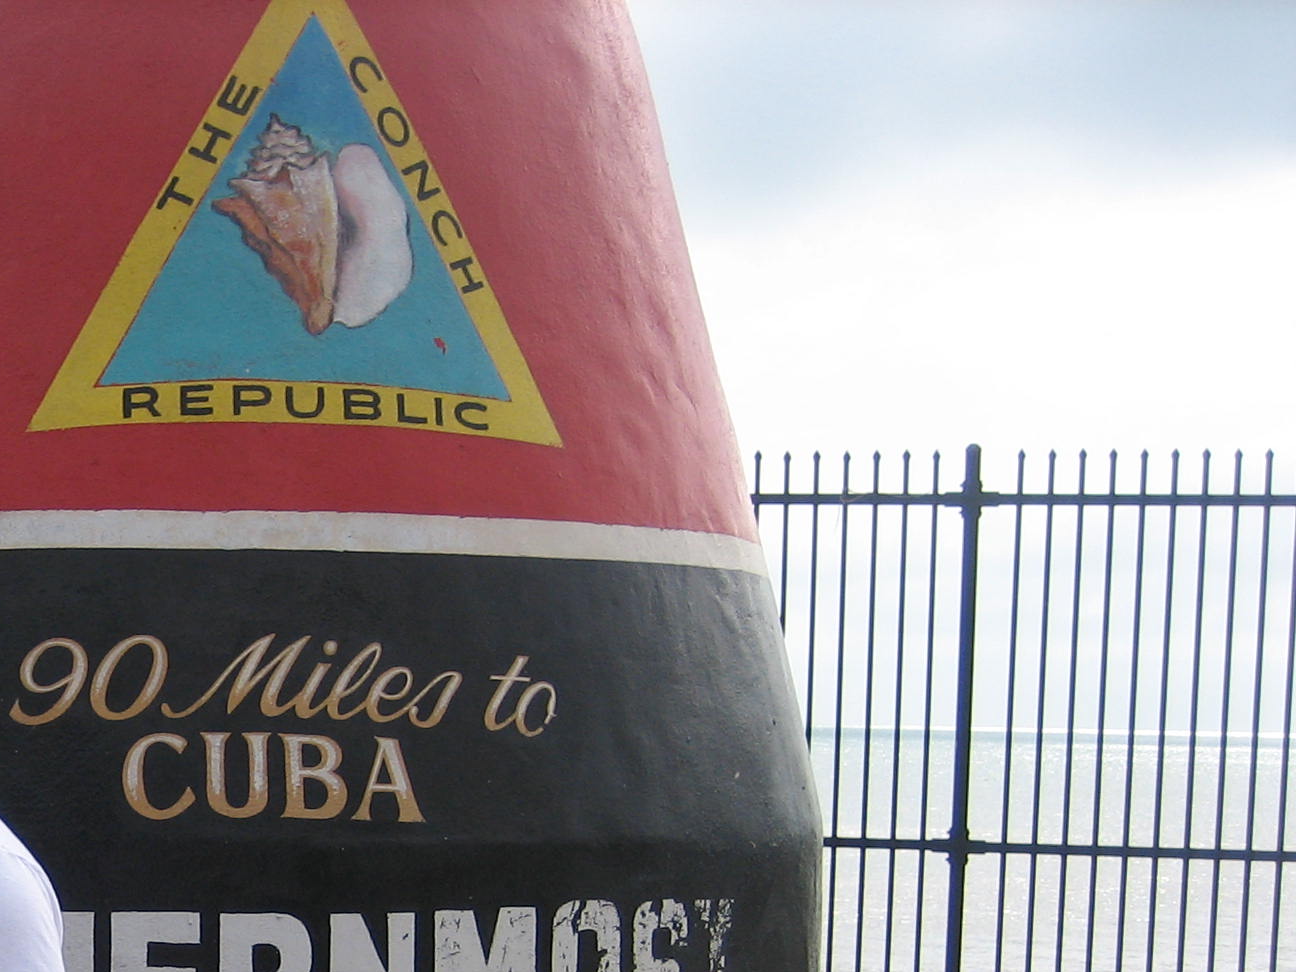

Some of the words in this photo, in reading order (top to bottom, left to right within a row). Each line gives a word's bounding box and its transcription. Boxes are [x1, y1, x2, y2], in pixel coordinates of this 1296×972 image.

[156, 75, 263, 211] THE
[349, 56, 484, 294] CONCH
[122, 384, 489, 430] REPUBLIC
[8, 634, 168, 726] 90
[161, 633, 463, 728] Miles
[483, 655, 557, 737] to
[121, 732, 426, 822] CUBA
